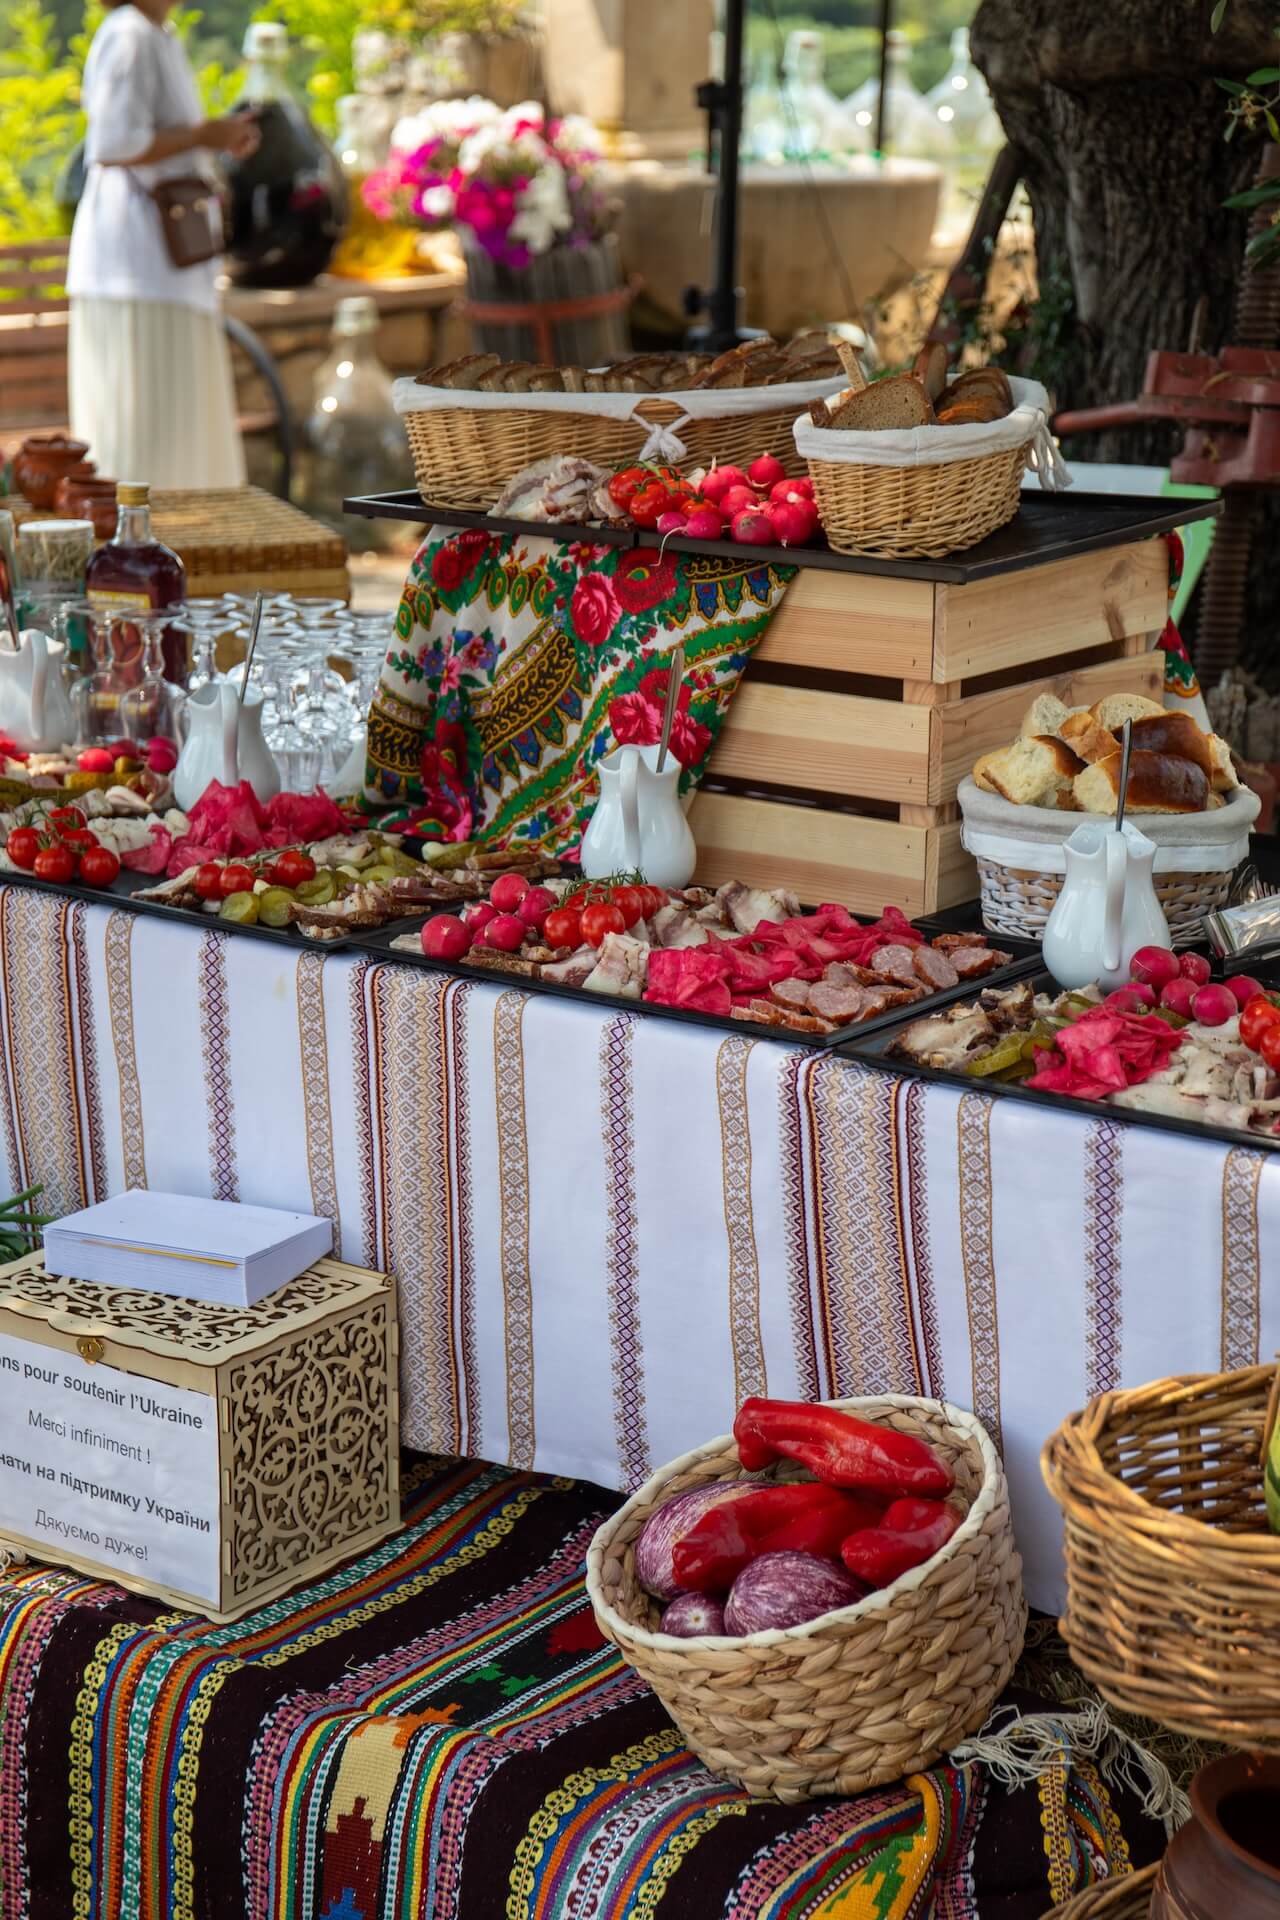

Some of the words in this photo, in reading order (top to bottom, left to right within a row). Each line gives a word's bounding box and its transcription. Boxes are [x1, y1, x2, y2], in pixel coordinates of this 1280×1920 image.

[0, 1355, 20, 1372] ns
[24, 1363, 59, 1385] pour
[63, 1375, 126, 1407] soutenir
[28, 1409, 66, 1437] Merci
[71, 1424, 142, 1461] infiniment
[146, 1448, 151, 1464] !
[36, 1465, 55, 1482] на
[60, 1472, 140, 1511] підтримку
[145, 1497, 210, 1533] України
[35, 1508, 100, 1545] Дякуємо
[104, 1536, 149, 1561] дуже!
